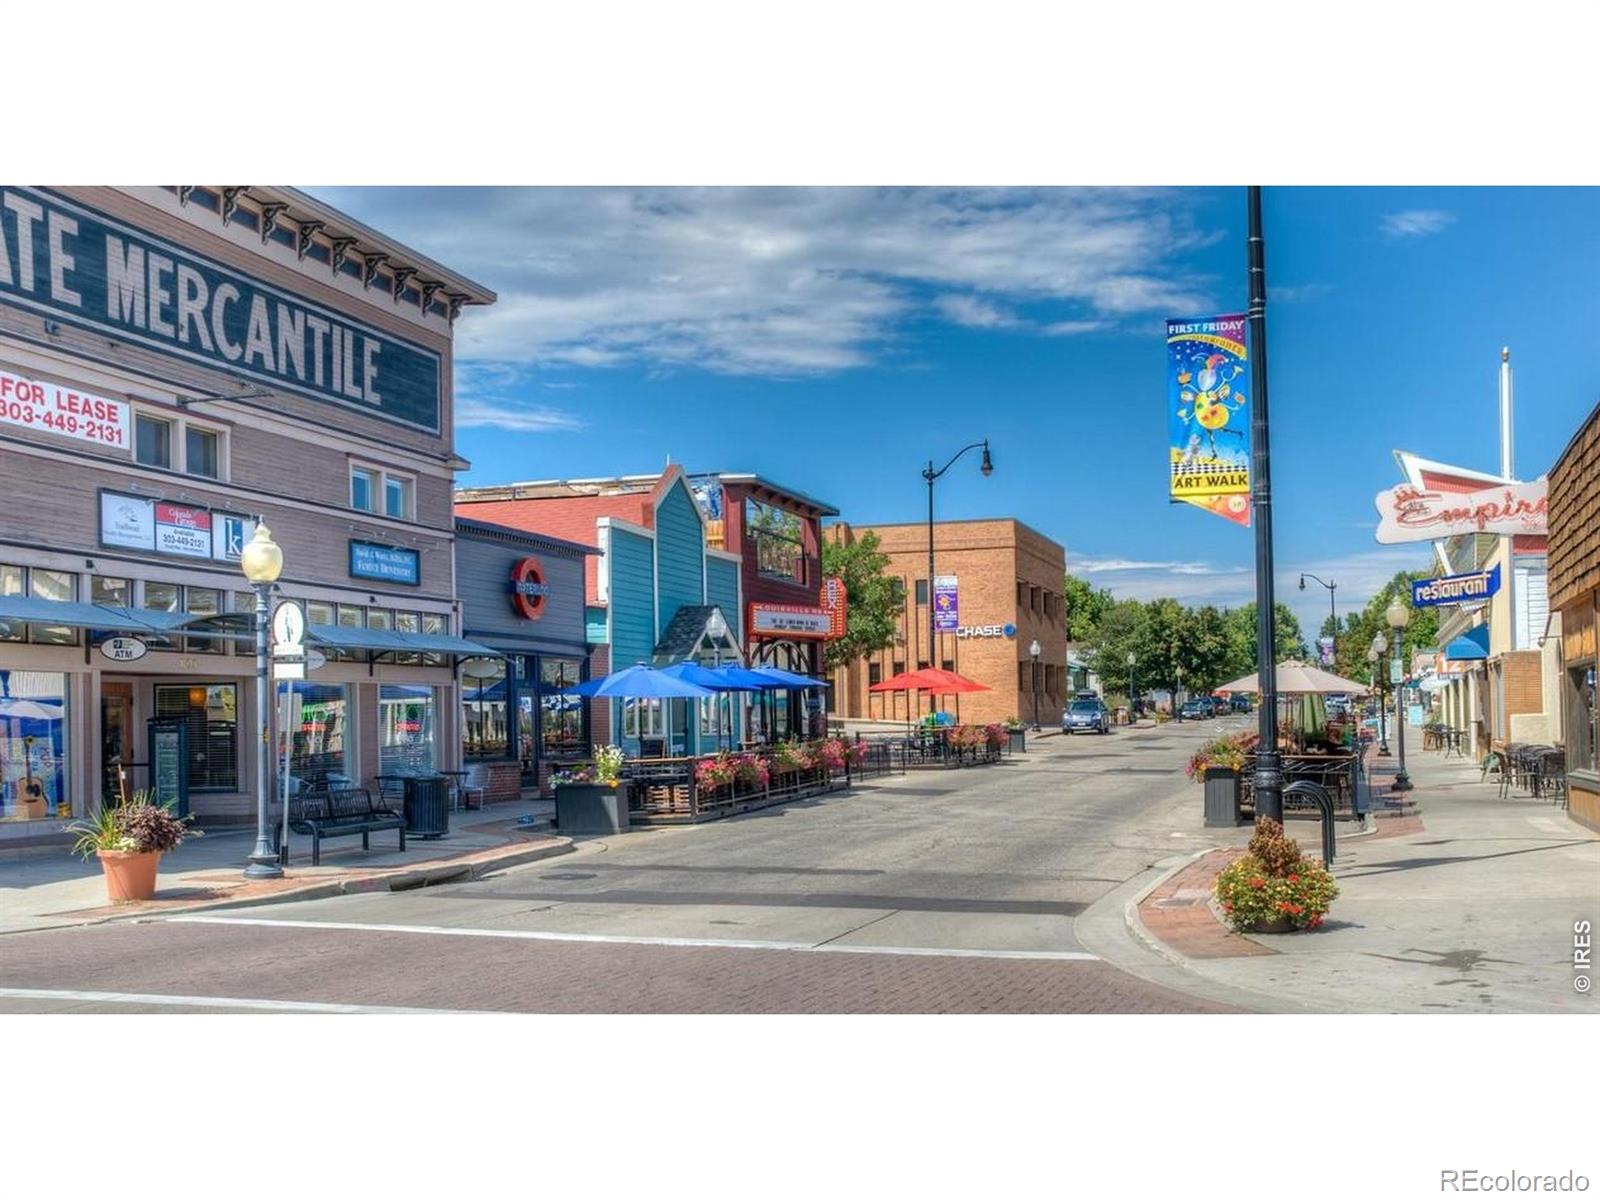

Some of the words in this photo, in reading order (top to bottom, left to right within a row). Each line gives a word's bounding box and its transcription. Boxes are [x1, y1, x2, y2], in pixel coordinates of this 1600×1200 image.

[106, 234, 381, 406] MERCANTILE
[1168, 324, 1200, 334] FIRST
[1202, 320, 1244, 332] FRIDAY
[1, 377, 45, 406] FOR
[56, 390, 119, 423] LEASE
[1174, 476, 1202, 488] ART
[1206, 474, 1247, 486] WALK
[1415, 572, 1491, 601] restaurant
[957, 625, 1001, 637] CHASE
[114, 650, 133, 659] ATM
